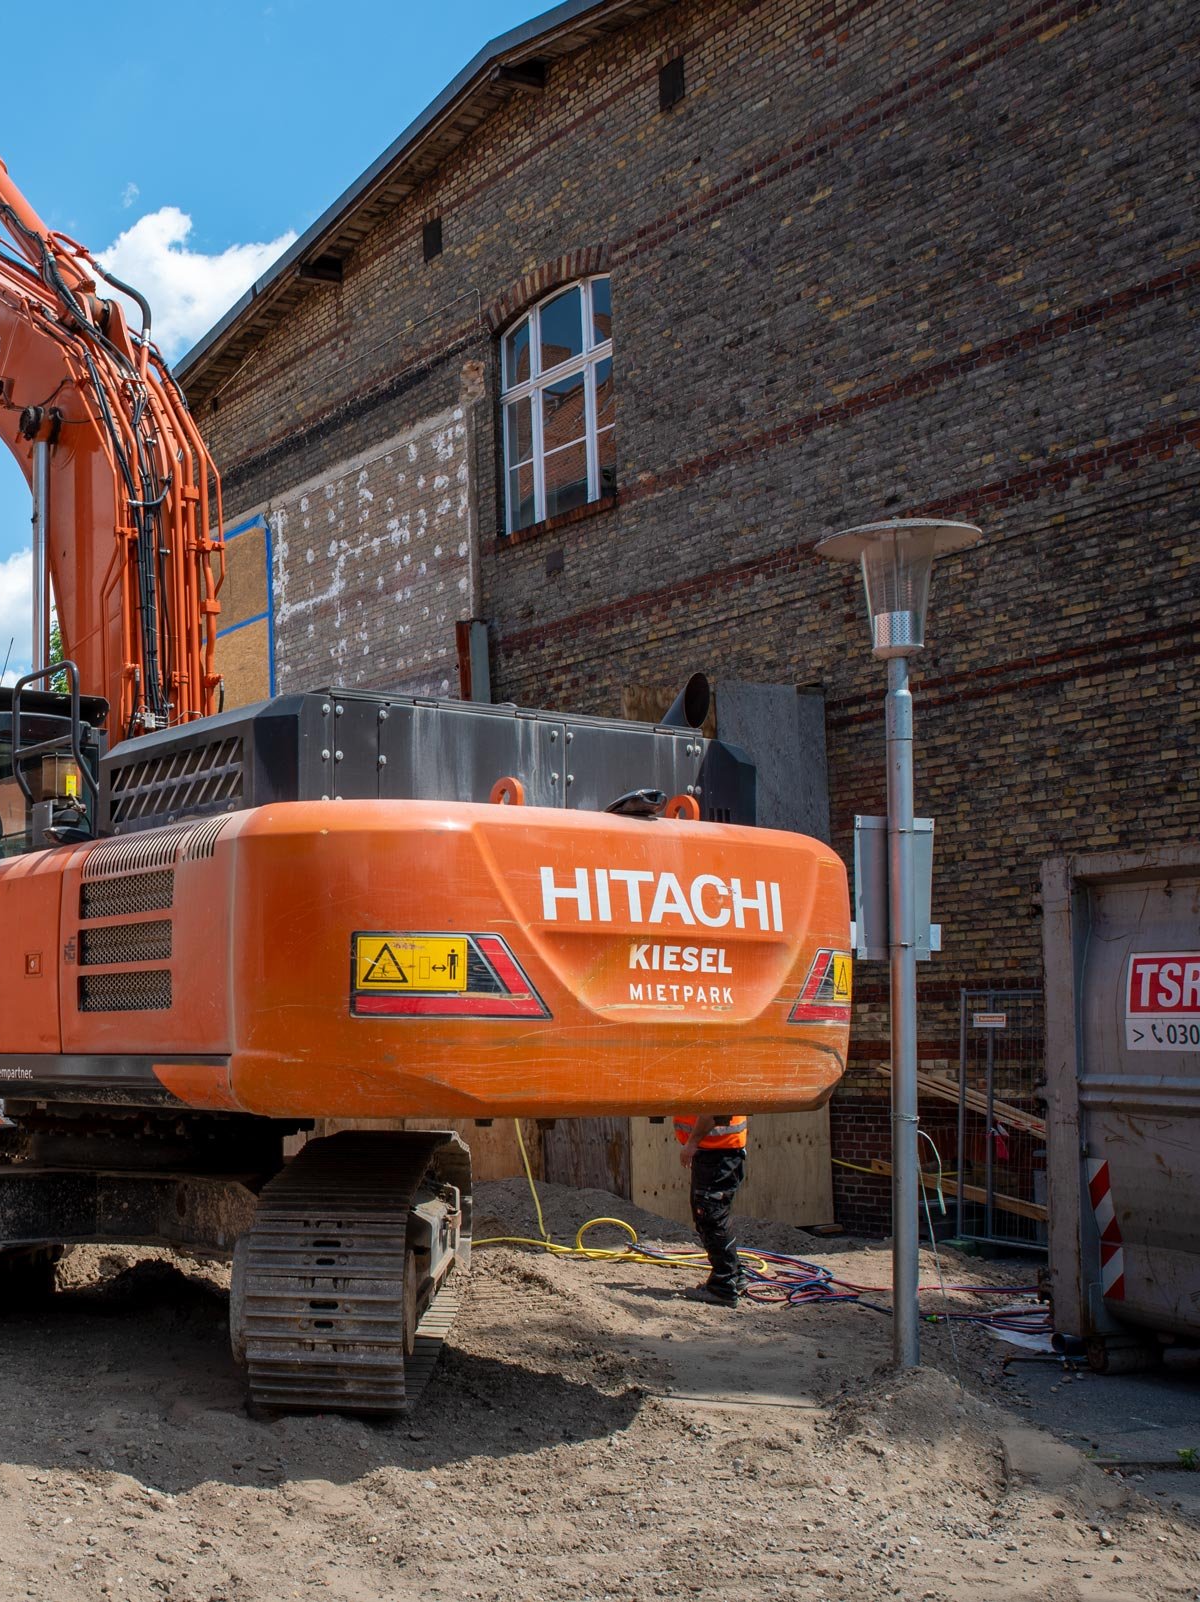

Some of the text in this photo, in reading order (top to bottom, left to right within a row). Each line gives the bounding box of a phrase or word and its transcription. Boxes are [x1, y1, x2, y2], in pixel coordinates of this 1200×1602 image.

[540, 866, 784, 932] HITACHI
[629, 944, 733, 974] KIESEL
[629, 983, 734, 1004] MIETPARK
[1136, 962, 1200, 1008] TSR
[1167, 1024, 1200, 1045] 030
